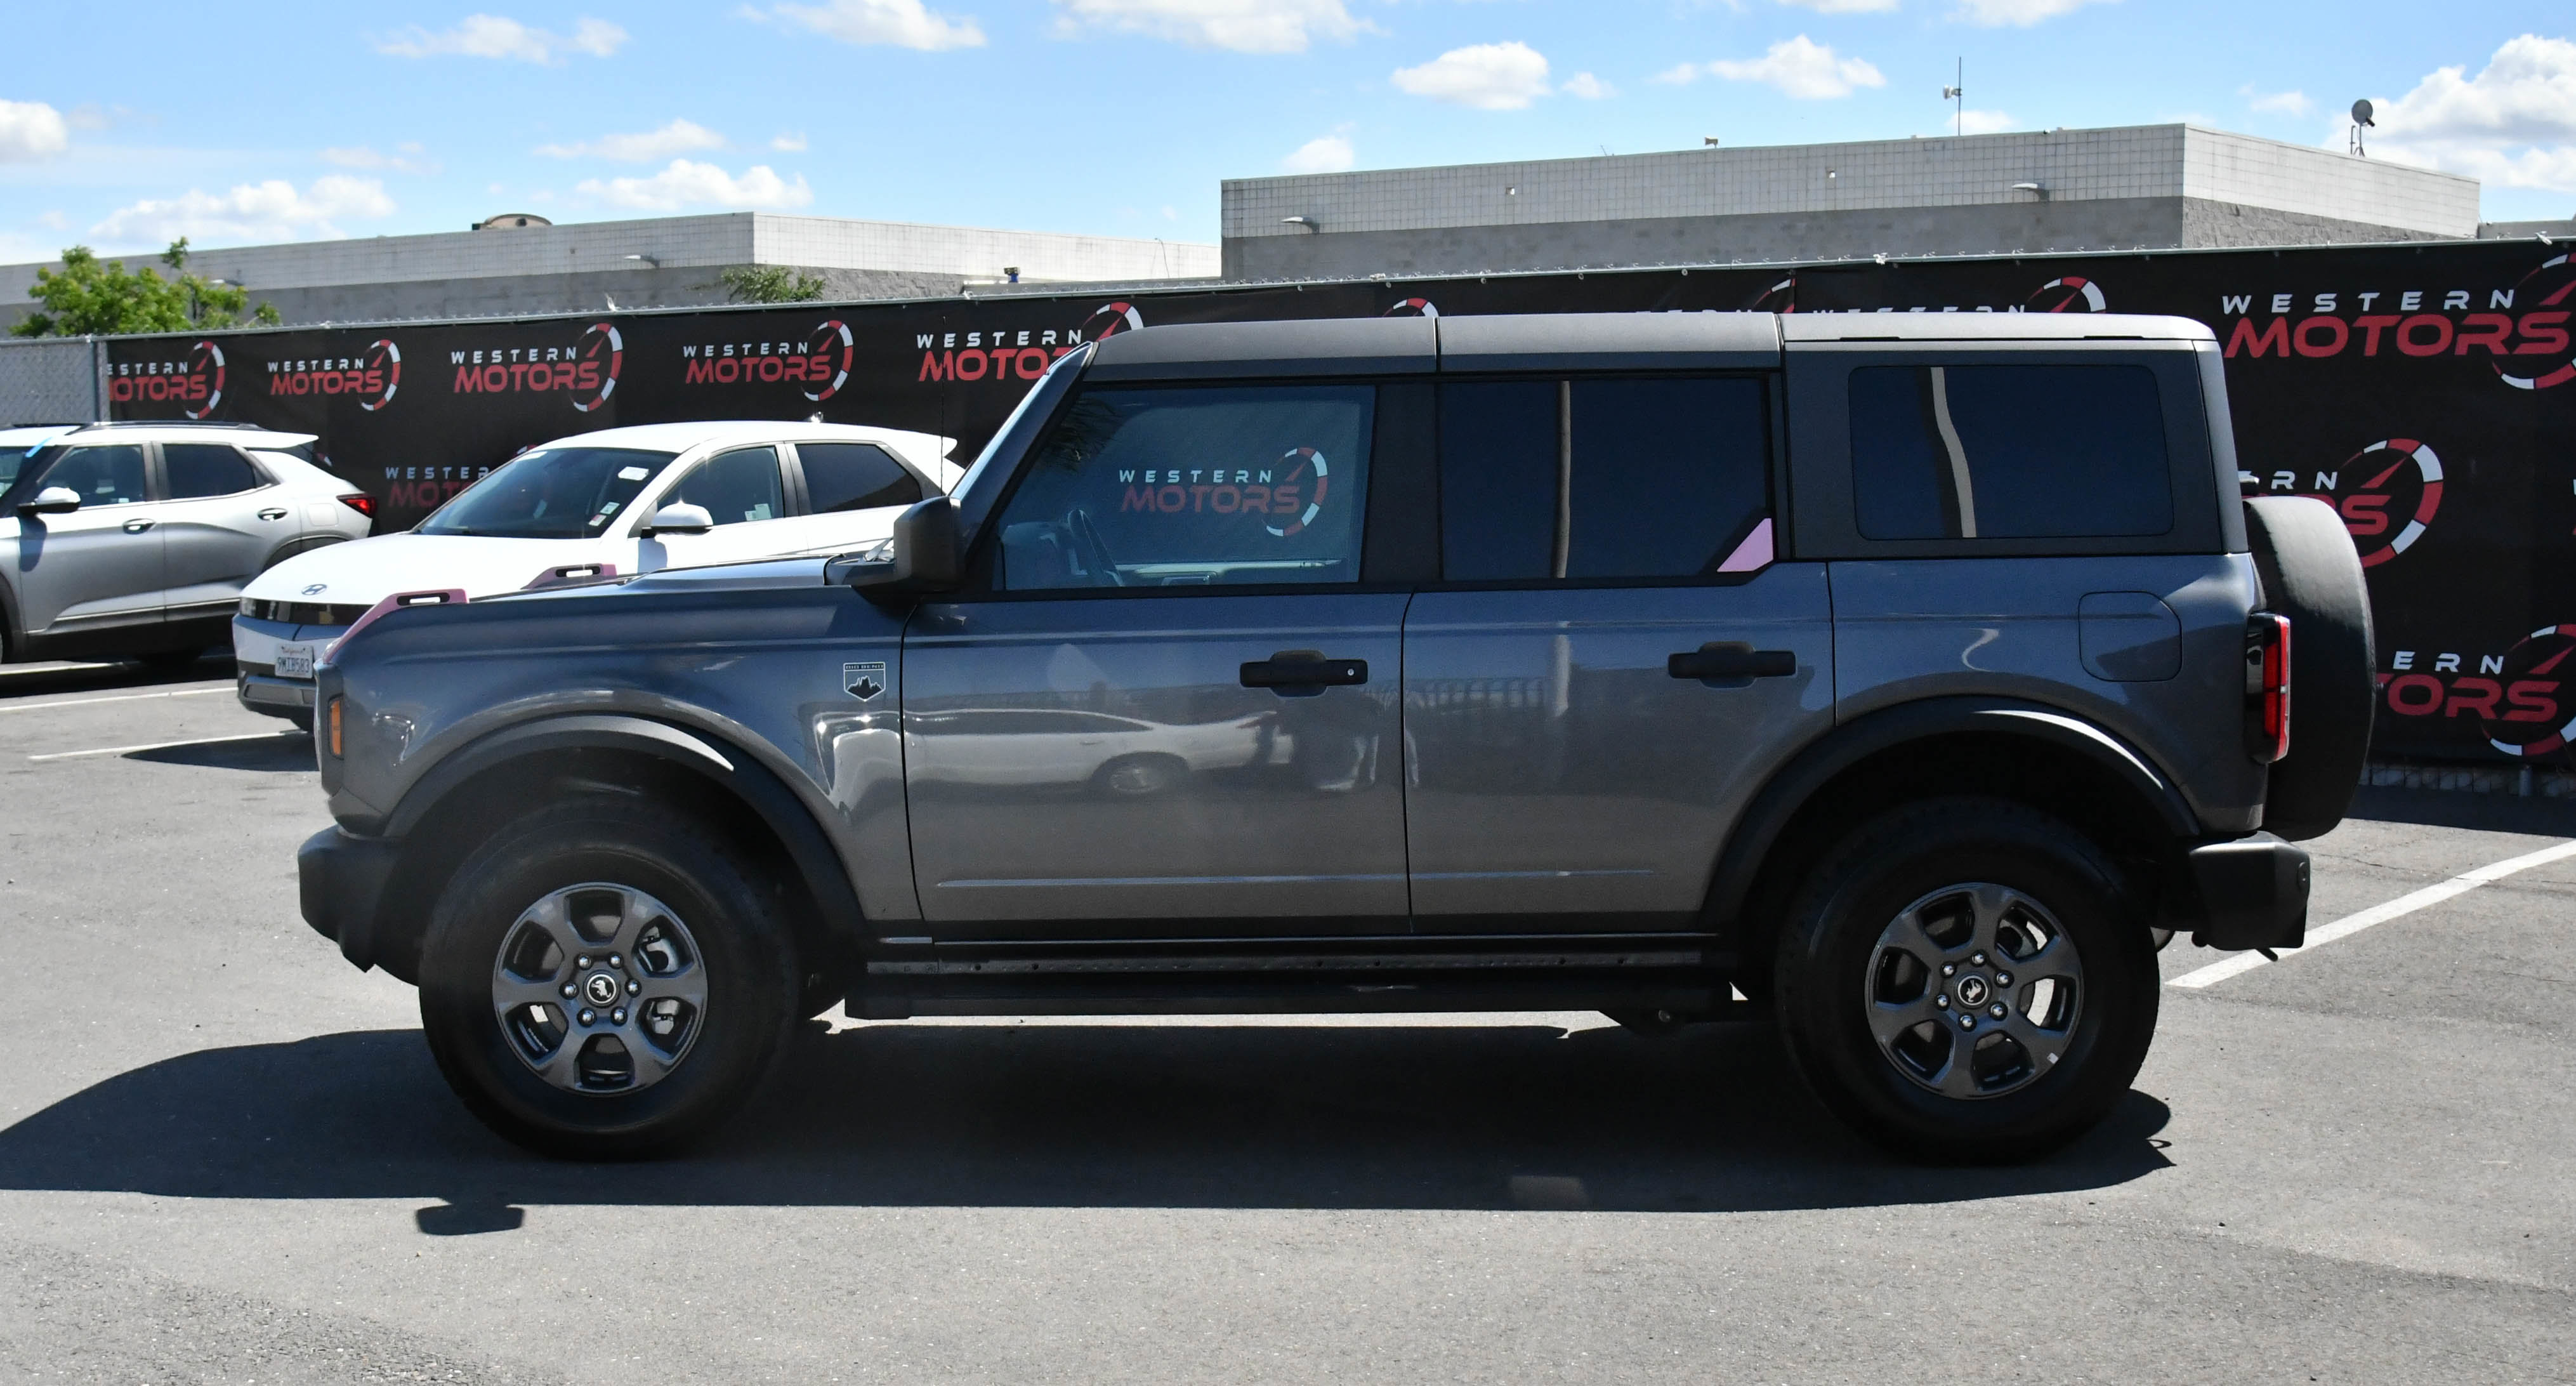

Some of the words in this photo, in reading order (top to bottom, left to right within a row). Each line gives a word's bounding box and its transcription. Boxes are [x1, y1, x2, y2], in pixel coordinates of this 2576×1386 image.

[2222, 289, 2514, 315] WESTERN
[917, 329, 1081, 348] WESTERN
[2223, 312, 2572, 358] MOTORS
[451, 346, 577, 364] WESTERN
[683, 341, 808, 357] WESTERN
[267, 358, 364, 373] WESTERN
[454, 361, 600, 393] MOTORS
[685, 355, 831, 384] MOTORS
[270, 370, 383, 395] MOTORS
[1119, 470, 1272, 483] WESTERN
[388, 481, 471, 507] MOT
[1119, 484, 1300, 513] MOTORS
[2393, 650, 2504, 675] ERN
